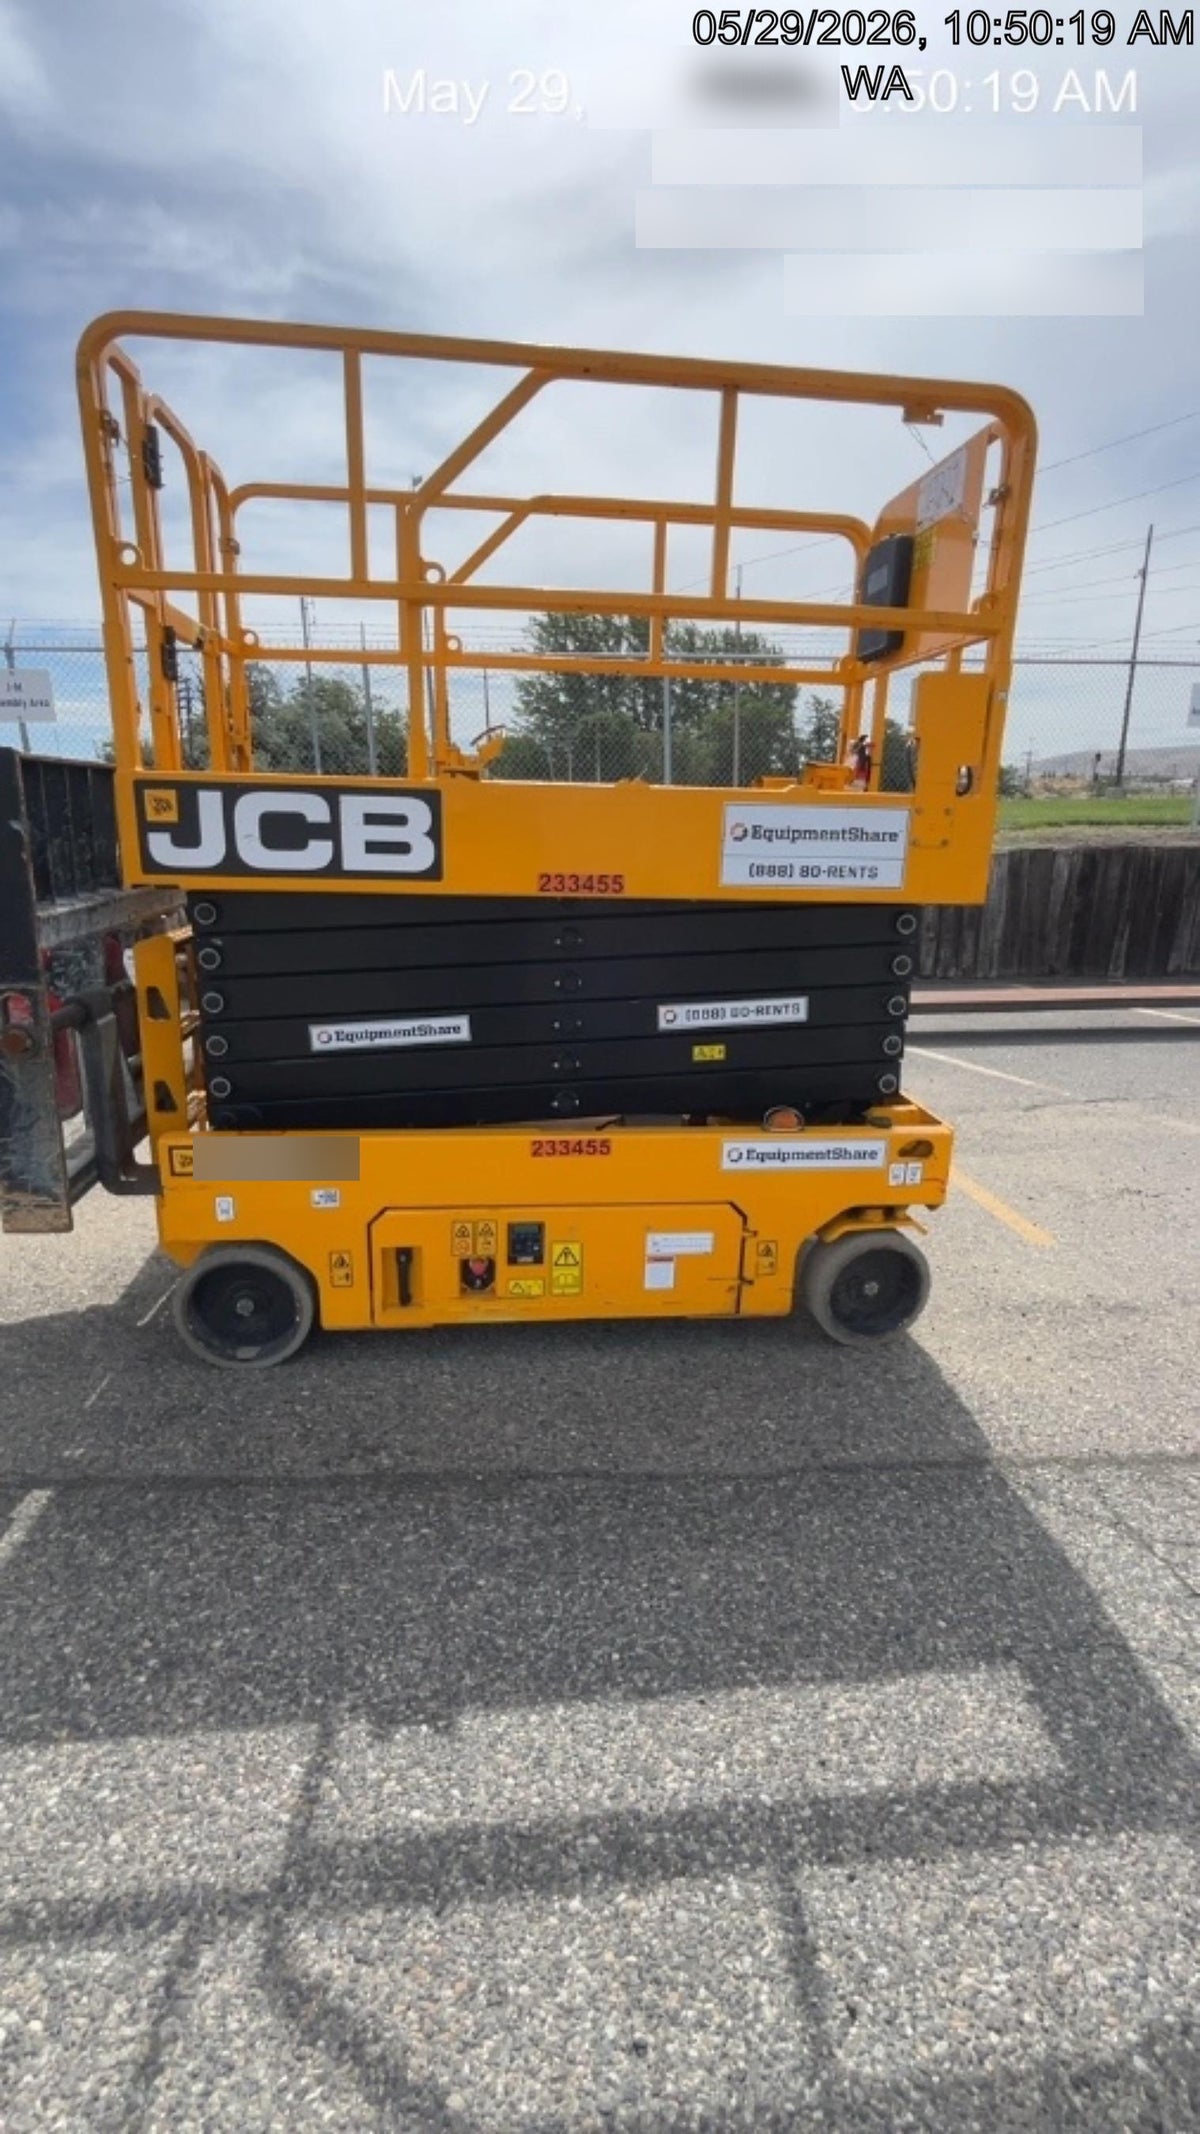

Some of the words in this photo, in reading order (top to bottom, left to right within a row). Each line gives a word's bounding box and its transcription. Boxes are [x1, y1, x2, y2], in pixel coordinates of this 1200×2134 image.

[146, 788, 436, 873] JCB
[750, 824, 900, 845] EquipmentShare
[748, 861, 795, 879] (888)
[799, 863, 879, 880] 80-RENTS
[538, 872, 625, 894] 233455
[334, 1024, 461, 1044] EquipmentShare
[530, 1139, 611, 1157] 233455
[745, 1147, 878, 1164] EquipmentShare
